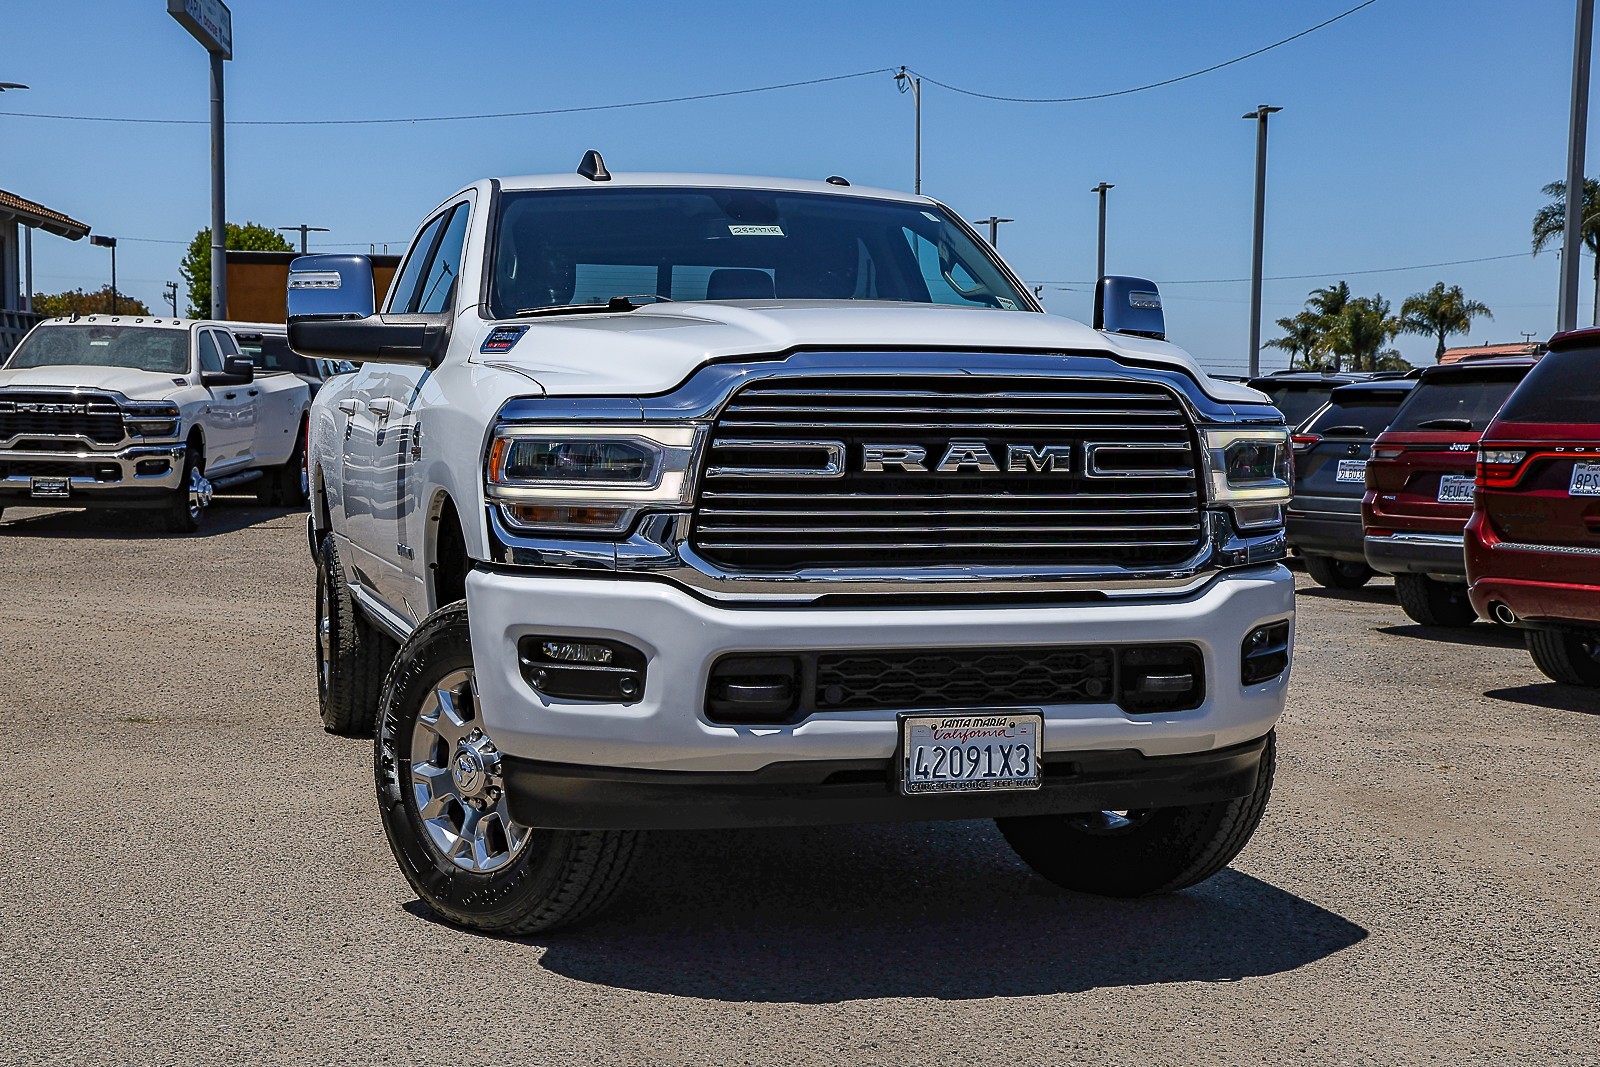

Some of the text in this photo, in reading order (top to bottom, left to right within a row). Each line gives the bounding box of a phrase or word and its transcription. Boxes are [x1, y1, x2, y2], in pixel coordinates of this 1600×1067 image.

[16, 403, 86, 414] RAM
[1449, 442, 1471, 452] Jeep
[862, 441, 1071, 472] RAM
[939, 717, 1008, 729] SANTA MARIA
[933, 727, 1015, 745] California
[914, 744, 1030, 780] 42091X3
[960, 780, 991, 790] DODGE
[1016, 778, 1037, 788] RAM
